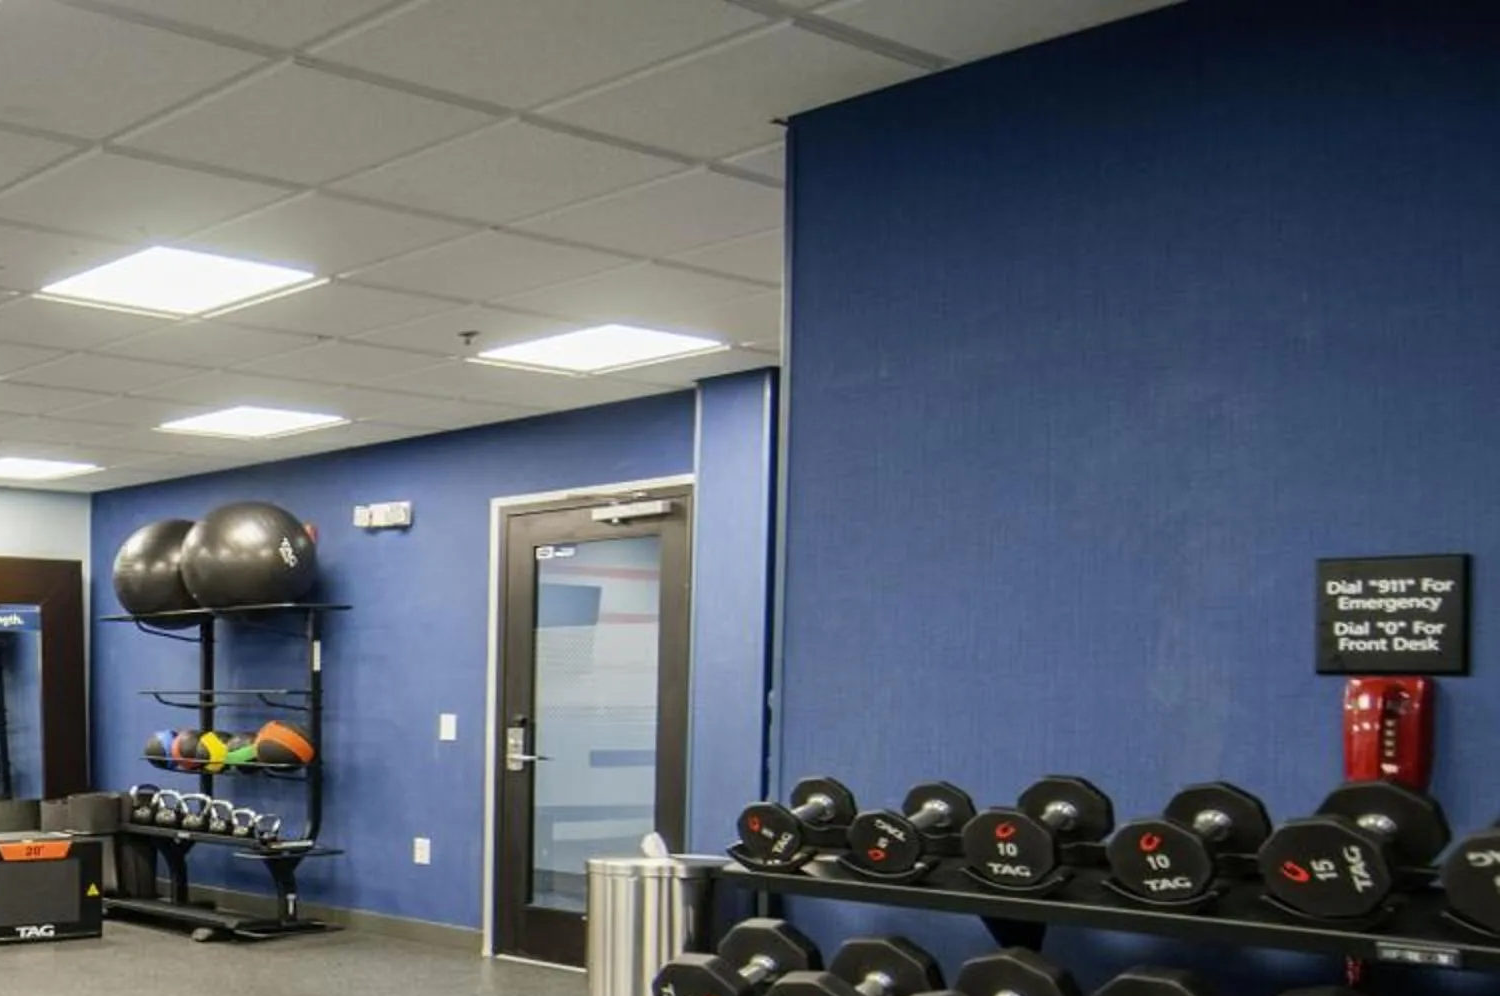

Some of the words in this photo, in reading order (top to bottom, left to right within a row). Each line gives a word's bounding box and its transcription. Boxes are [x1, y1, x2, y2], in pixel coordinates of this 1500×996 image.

[1326, 580, 1363, 595] Dial
[1368, 578, 1416, 594] "911"
[1420, 577, 1455, 593] For
[1337, 596, 1443, 613] Emergency
[1333, 621, 1370, 637] Dial
[1412, 620, 1447, 636] For
[1338, 637, 1388, 652] Front
[1392, 636, 1440, 652] Desk
[997, 842, 1018, 857] 10
[987, 862, 1032, 877] TAG
[1146, 854, 1171, 870] 10
[1310, 859, 1338, 881] 15
[1343, 845, 1374, 893] TAG
[1143, 876, 1193, 892] TAG
[14, 924, 55, 939] TAG
